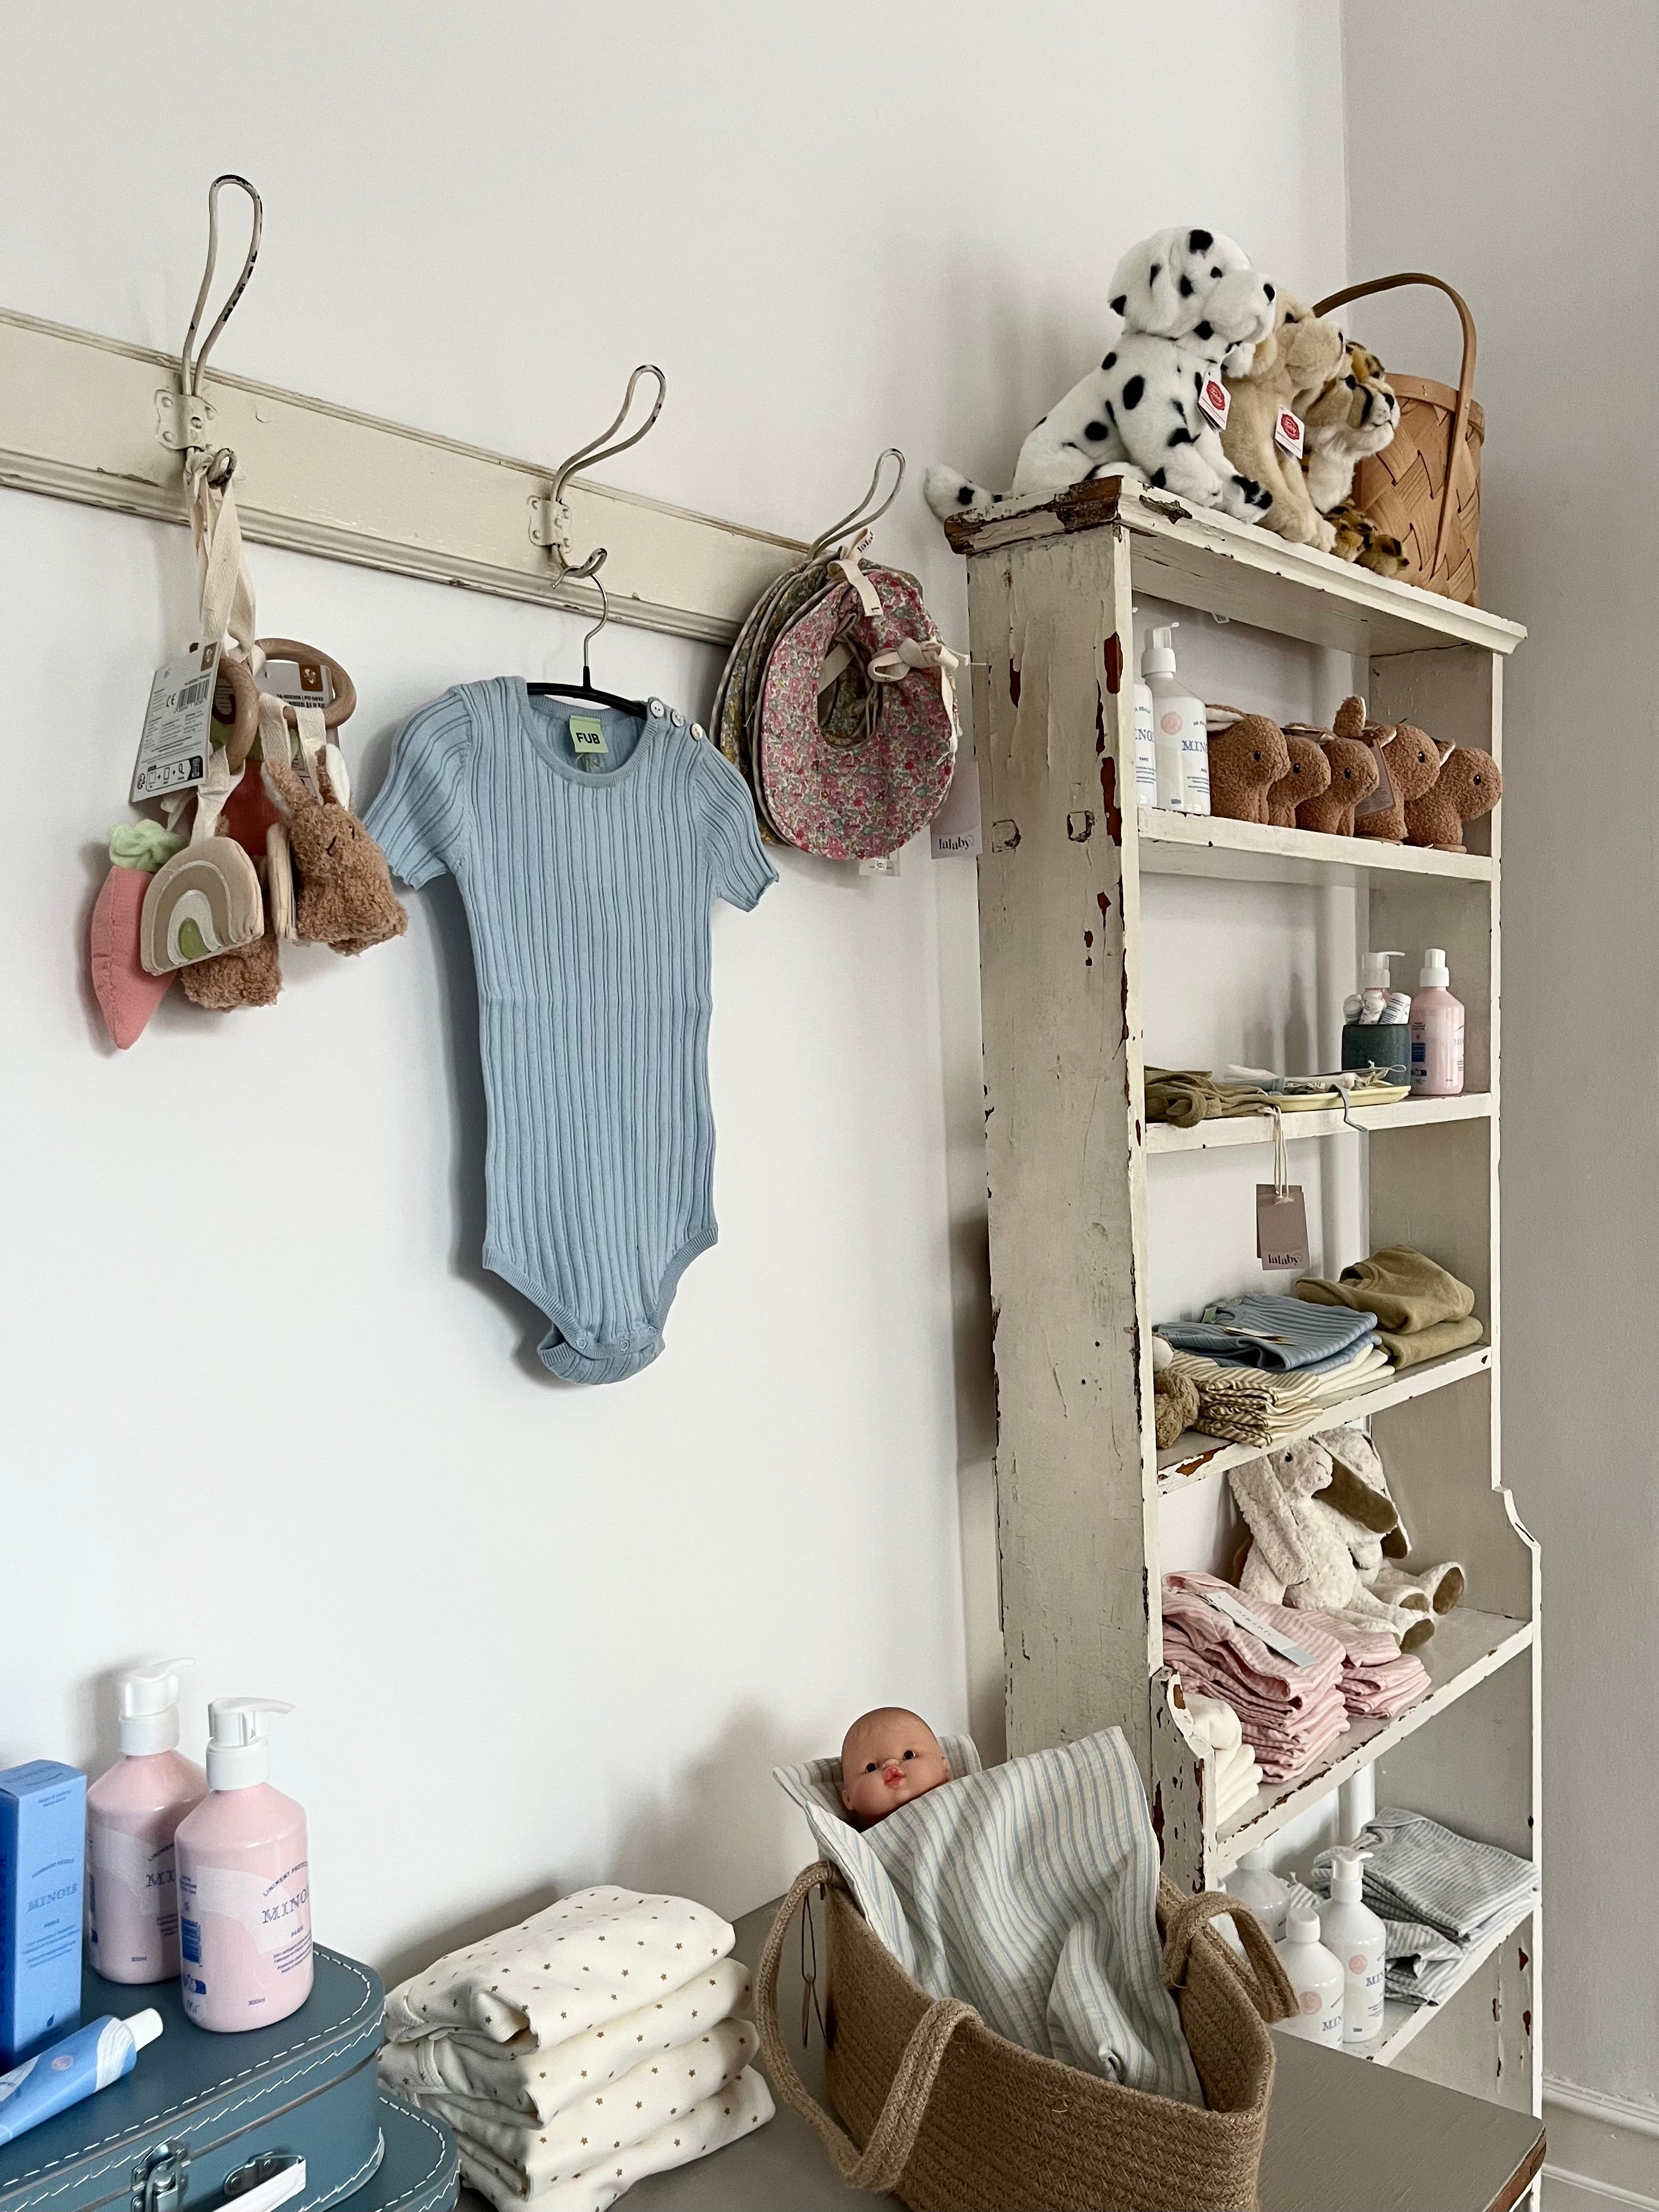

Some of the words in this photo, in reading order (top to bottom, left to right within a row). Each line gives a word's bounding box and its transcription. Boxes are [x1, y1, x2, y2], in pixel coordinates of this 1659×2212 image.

[576, 732, 600, 744] FUB
[939, 837, 969, 850] lalaby
[1268, 1254, 1297, 1266] lalaby
[27, 1883, 78, 1913] MINOIS
